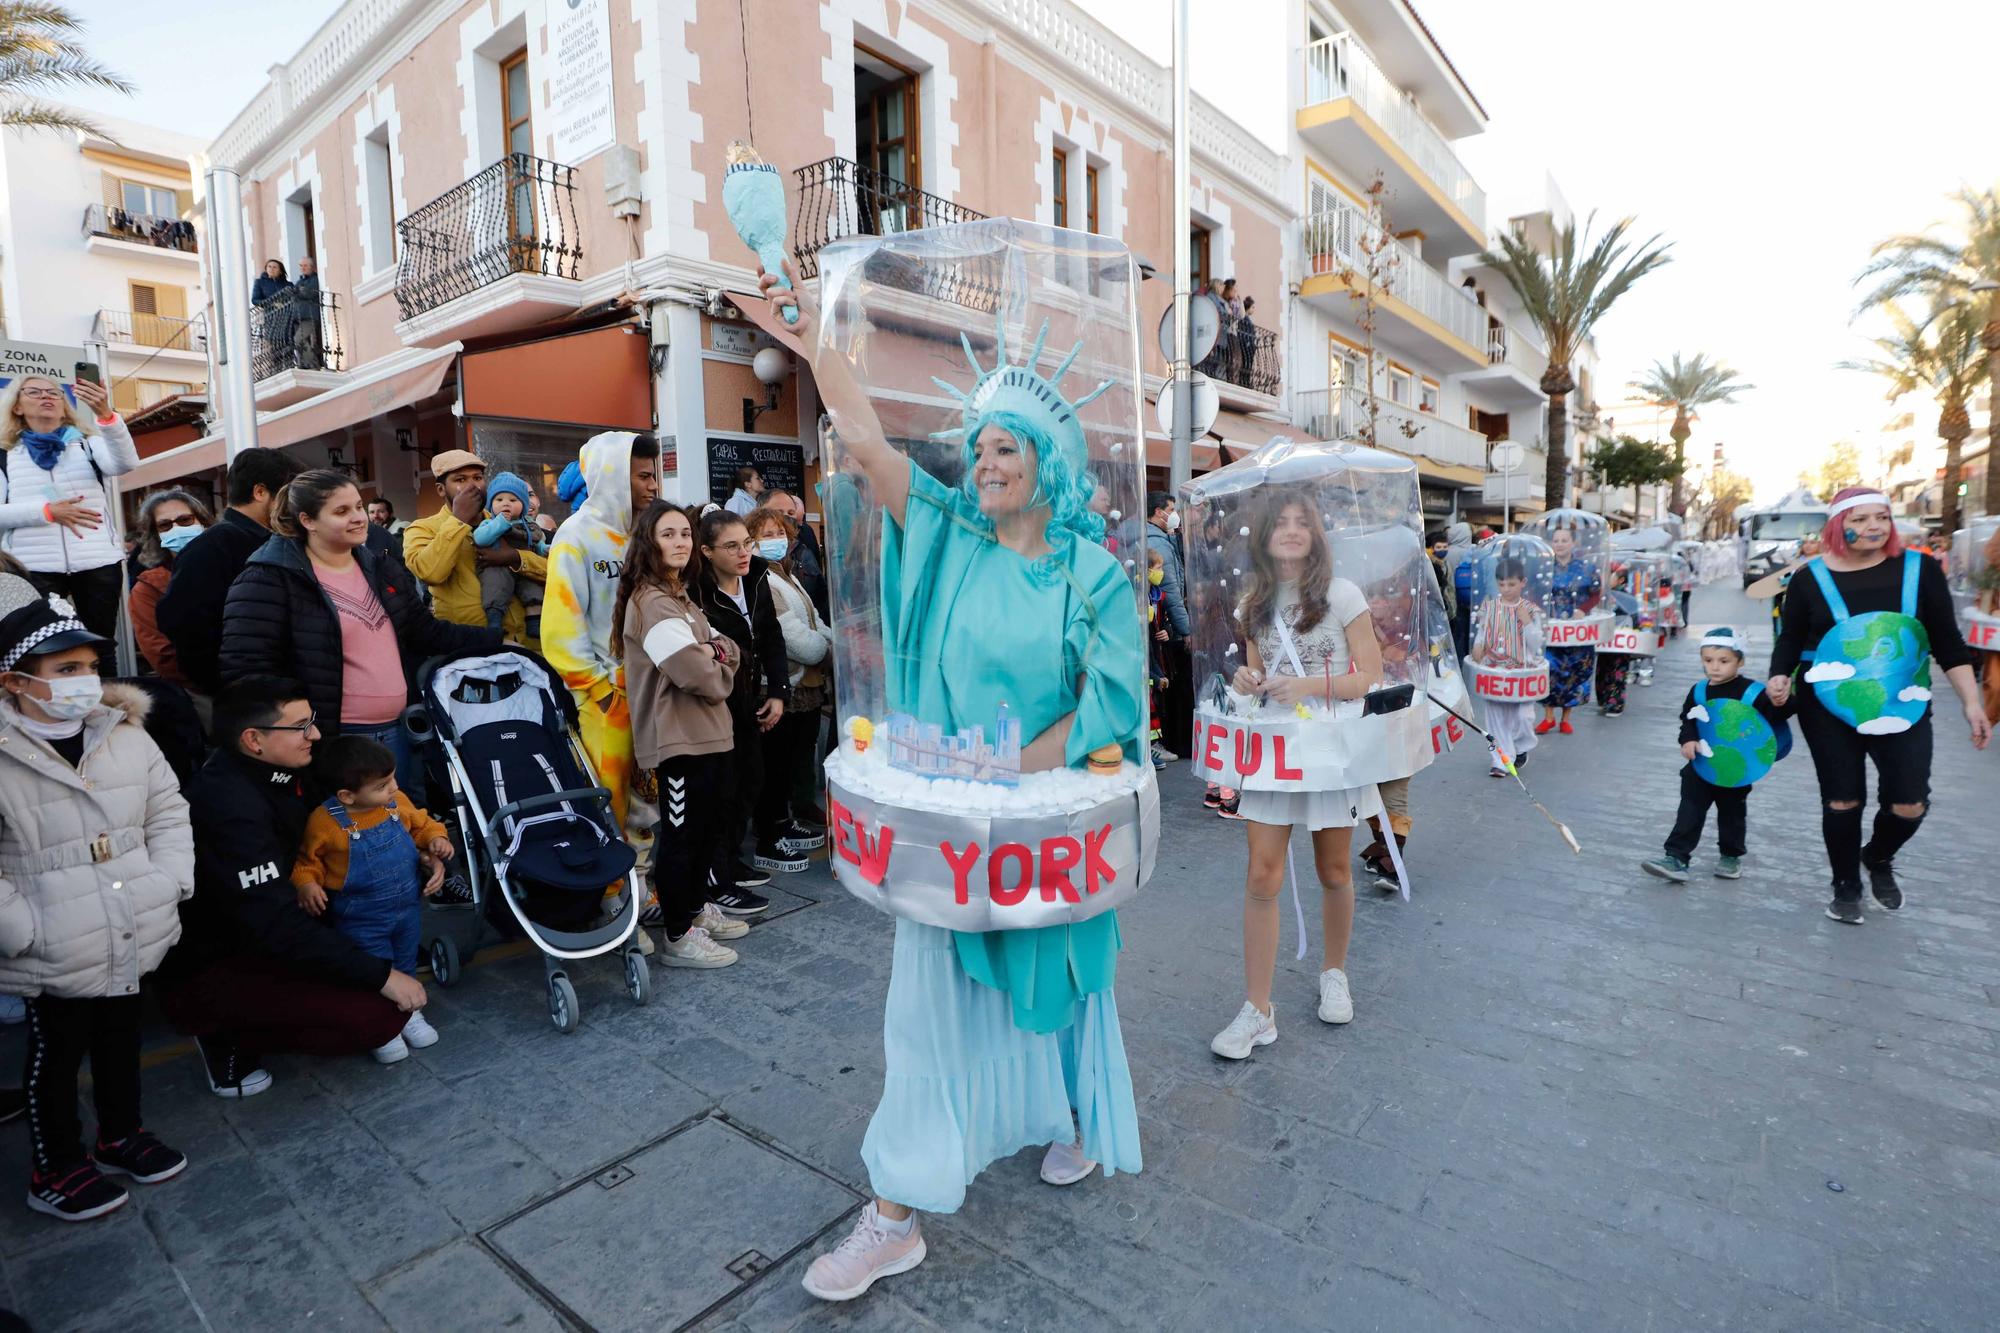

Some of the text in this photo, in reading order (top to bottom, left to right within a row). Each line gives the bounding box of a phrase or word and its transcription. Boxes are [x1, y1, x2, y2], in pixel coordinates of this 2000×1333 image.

[557, 1, 598, 33] ARCHIBIZA
[558, 27, 600, 58] ARQUITECTURA
[561, 19, 594, 46] ESTUDIO DE
[564, 38, 598, 66] URBANISMO
[4, 350, 47, 363] ZONA
[716, 342, 730, 350] Sant
[712, 443, 738, 460] TAPAS
[1543, 624, 1599, 642] APON
[1476, 674, 1547, 697] MEJICO
[1193, 720, 1303, 780] SEUL
[270, 772, 292, 784] HH
[238, 861, 280, 889] HH
[788, 862, 808, 871] BUFF
[939, 824, 1117, 906] YORK
